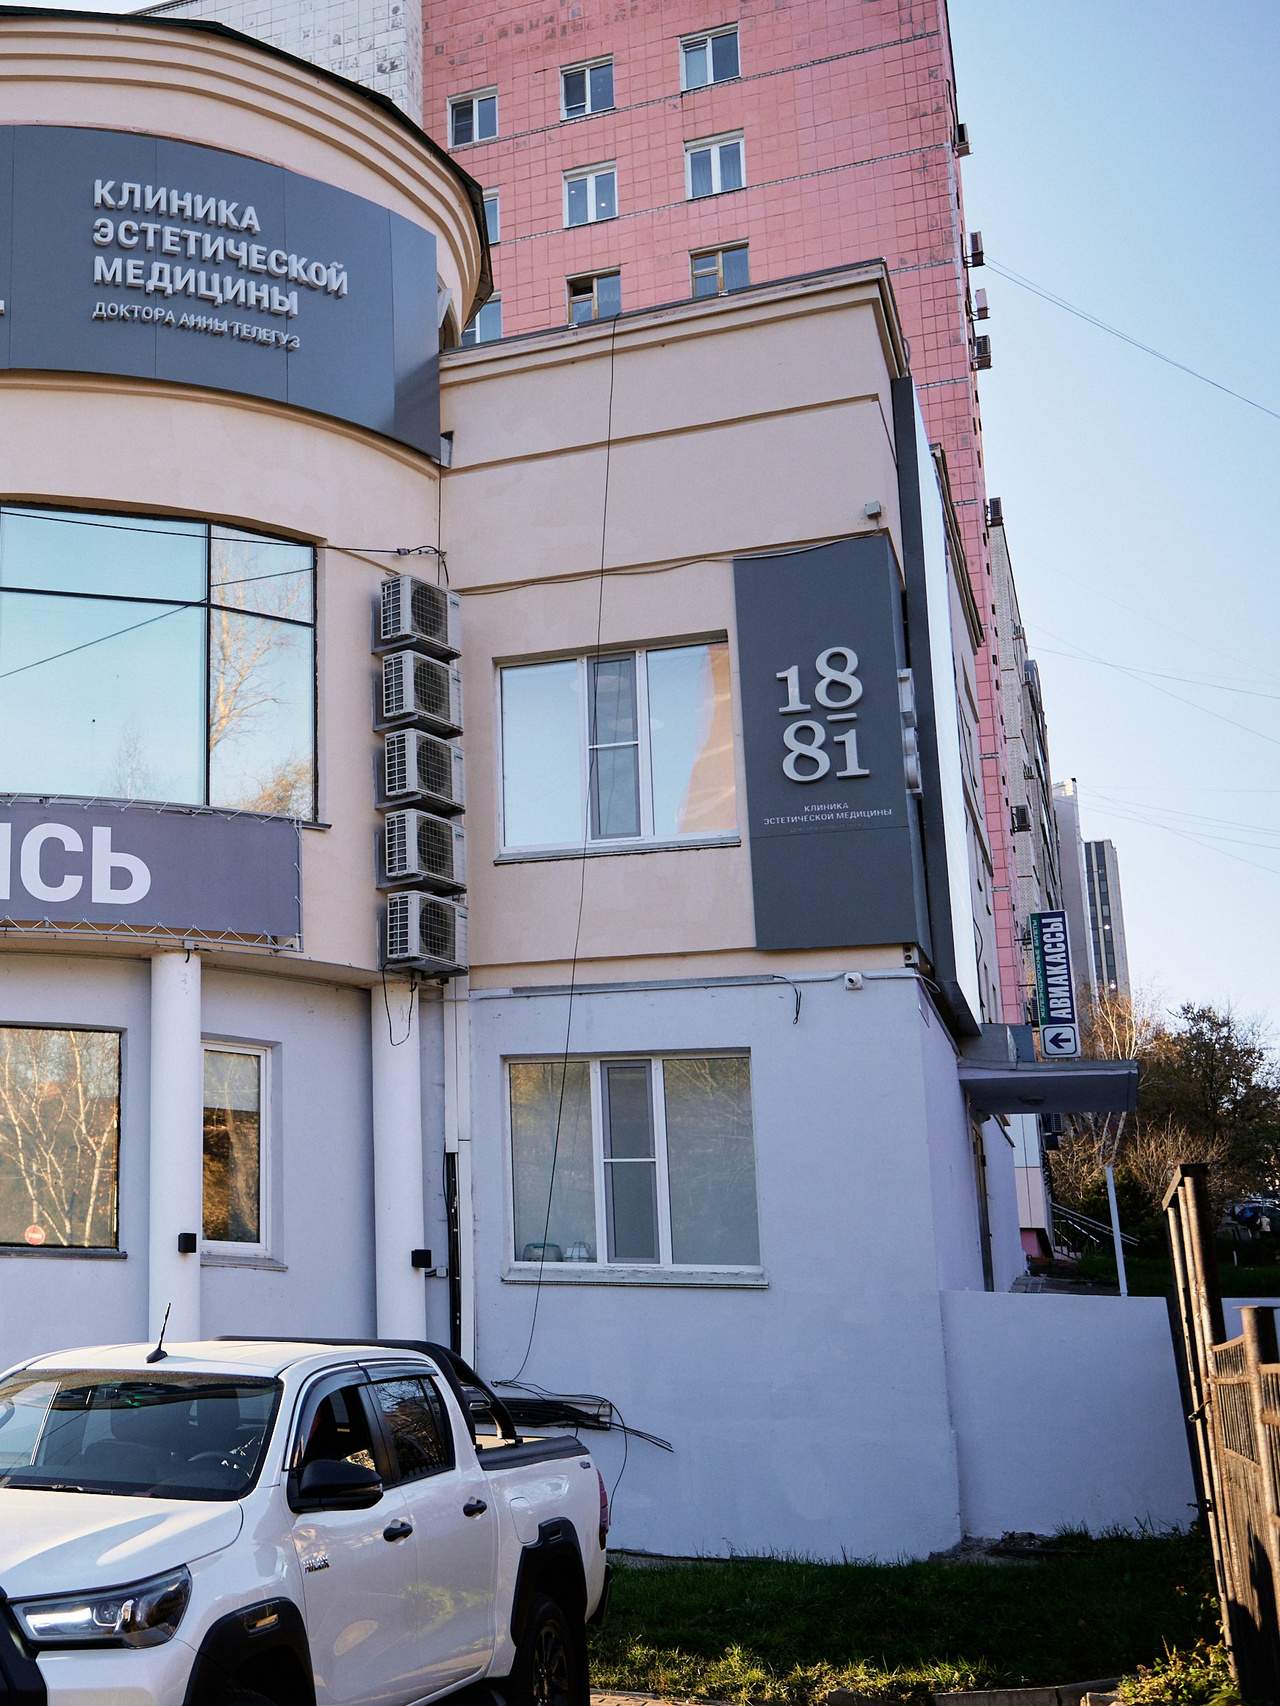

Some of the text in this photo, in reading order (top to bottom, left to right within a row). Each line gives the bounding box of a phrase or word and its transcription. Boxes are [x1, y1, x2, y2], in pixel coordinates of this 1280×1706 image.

[93, 179, 261, 235] КЛИНИКА
[92, 218, 348, 298] ЭСТЕТИЧЕСКОЙ
[93, 255, 299, 318] МЕДИЦИНЫ
[92, 301, 301, 350] ДОКТОРА АННЫ ТЕЛЕГУЗ
[775, 646, 863, 715] 18
[782, 719, 869, 783] 81
[763, 808, 892, 825] ЭСТЕТИЧЕСКОЙ МЕДИЦИНЫ
[804, 802, 849, 812] КЛИНИКА
[1032, 919, 1040, 947] БИЛЕТЫ
[1042, 917, 1072, 1019] АВИАКАССЫ
